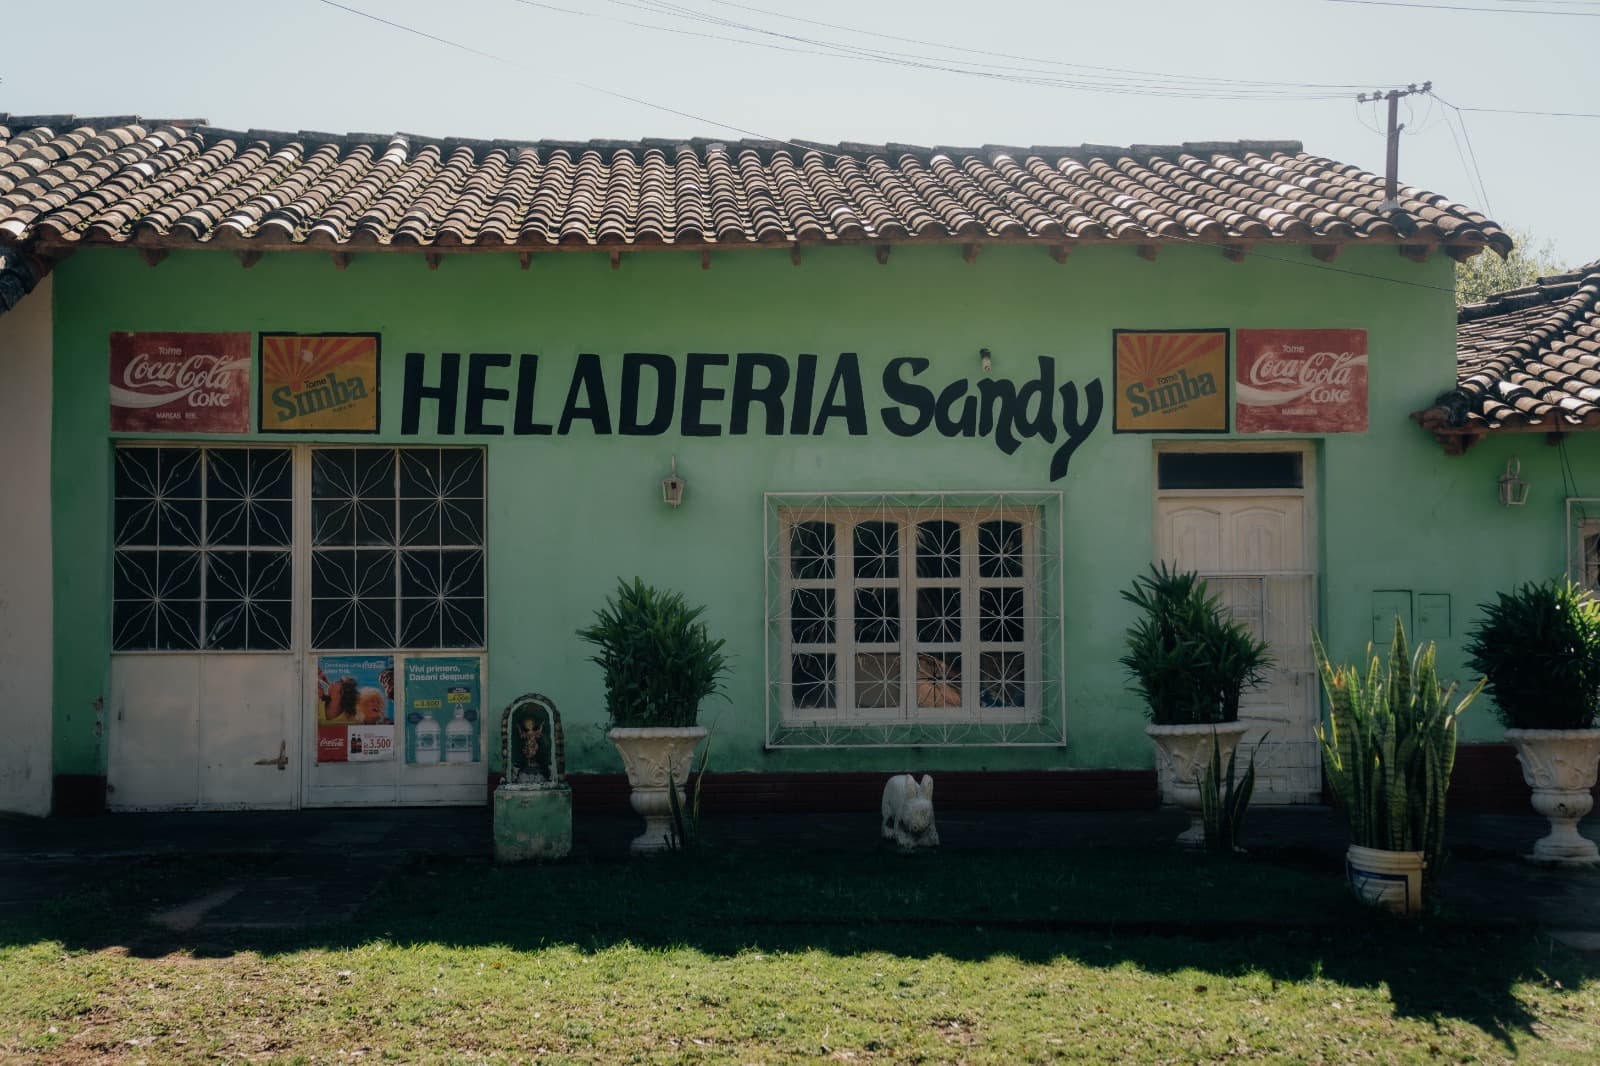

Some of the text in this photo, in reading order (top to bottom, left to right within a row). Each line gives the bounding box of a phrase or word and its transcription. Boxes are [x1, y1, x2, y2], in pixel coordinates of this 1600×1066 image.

[159, 346, 182, 356] Tome
[1282, 344, 1305, 353] Tome
[123, 353, 232, 389] Coca-Cola
[1249, 351, 1354, 386] Coca-Cola
[303, 377, 327, 389] Tome
[188, 390, 231, 407] Coke
[271, 372, 369, 422] Simba
[1126, 369, 1217, 418] Simba
[1310, 386, 1351, 404] Coke
[401, 352, 1104, 482] HELADERIA Sandy
[409, 673, 438, 681] Dasani
[369, 738, 391, 749] 3.500
